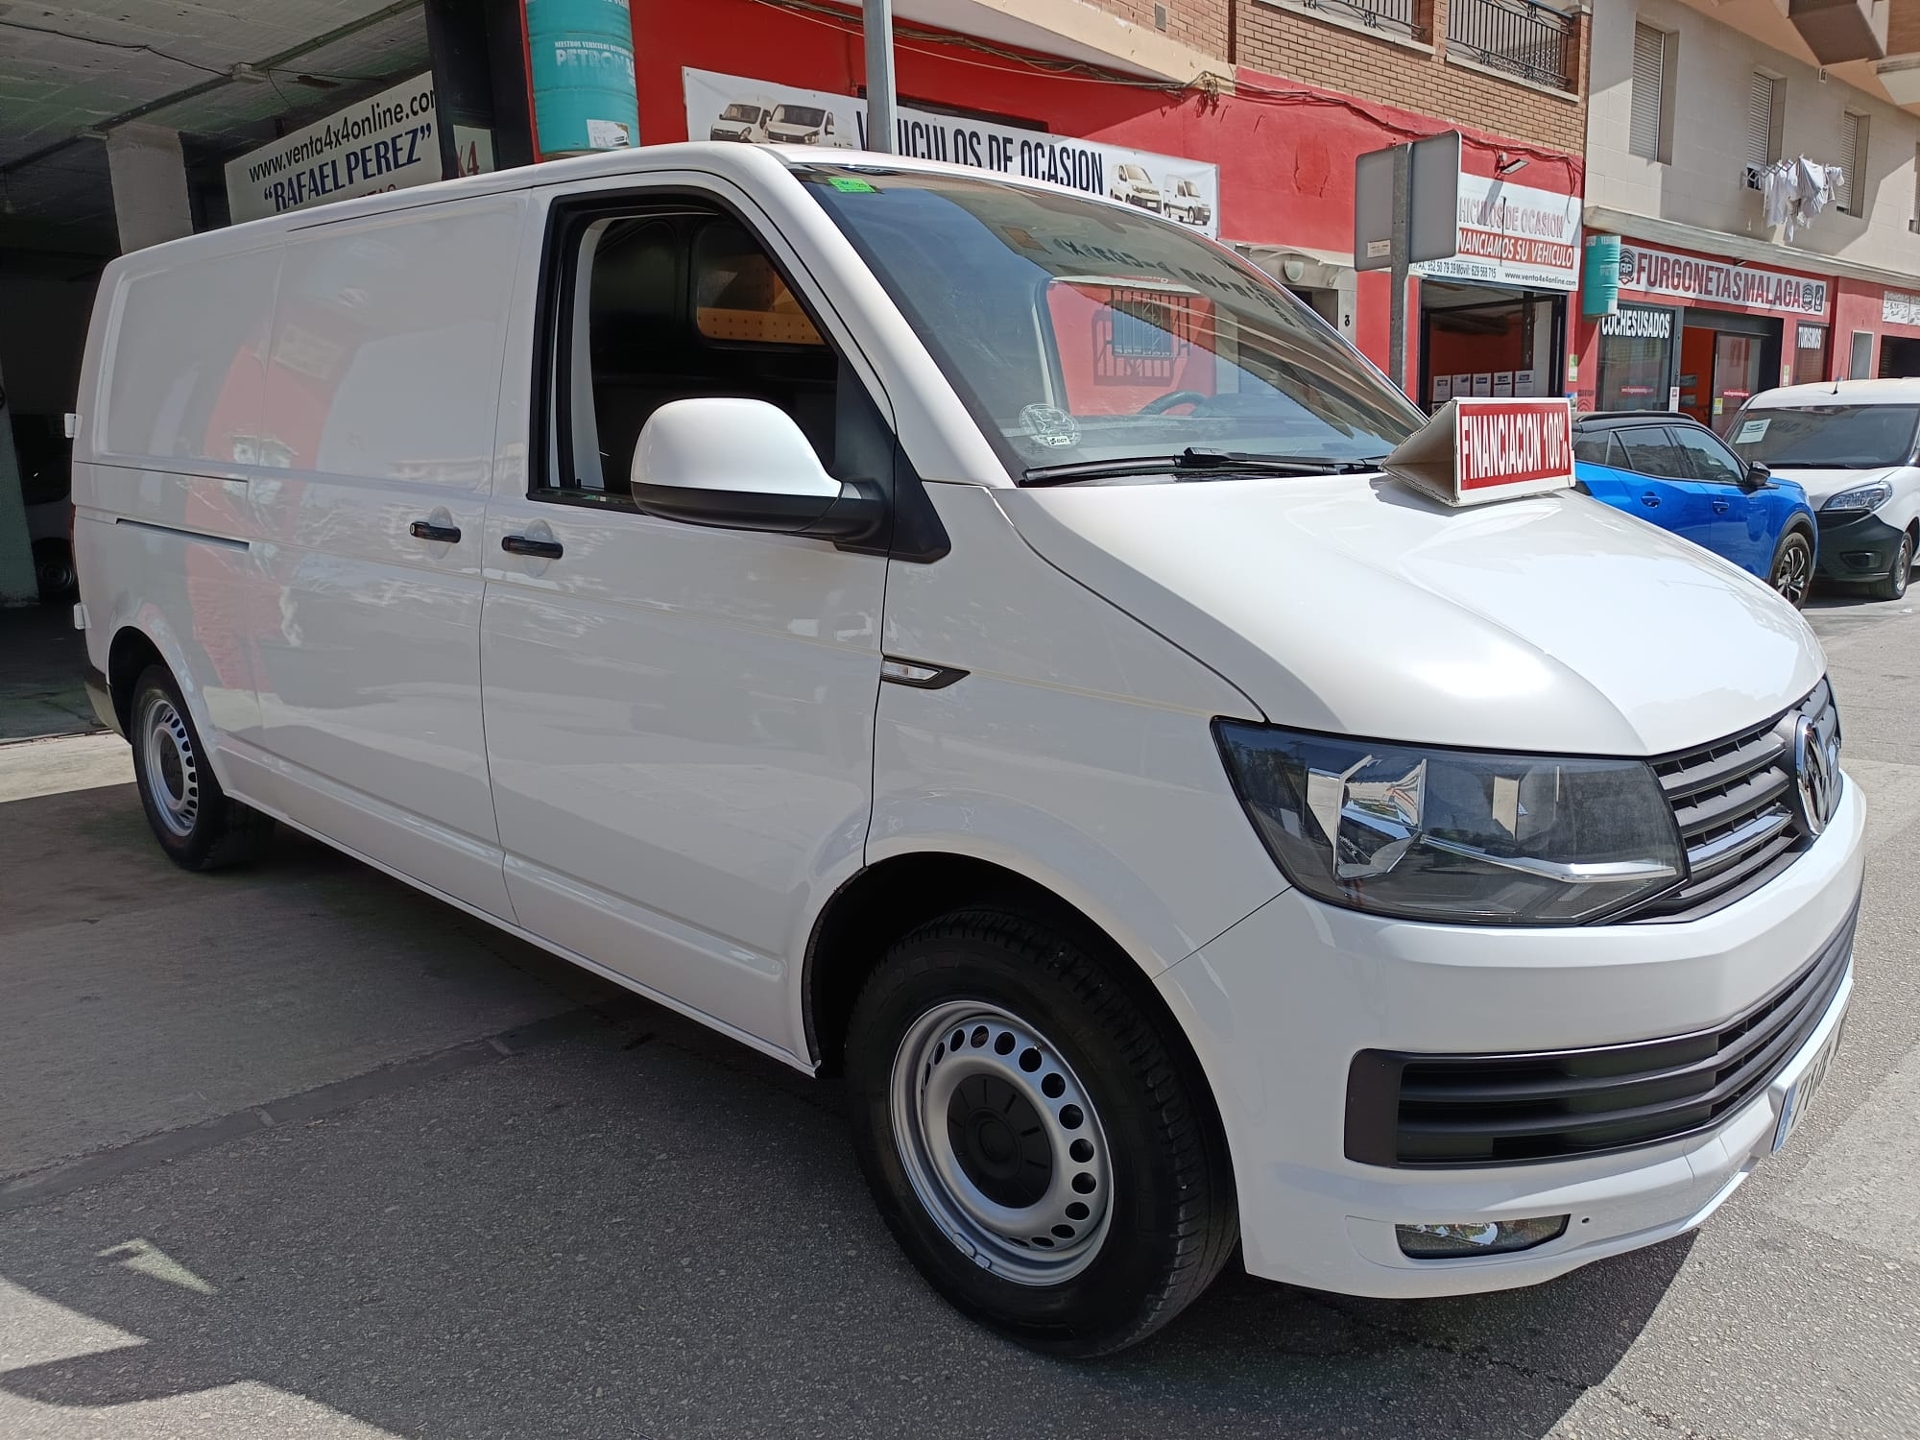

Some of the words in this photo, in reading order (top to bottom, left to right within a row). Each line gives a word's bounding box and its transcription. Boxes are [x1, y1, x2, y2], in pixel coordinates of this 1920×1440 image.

[988, 134, 1013, 173] DE
[1020, 140, 1103, 195] OCASION
[1505, 205, 1518, 231] DE
[1521, 207, 1564, 238] OCASION
[1515, 239, 1529, 261] SU
[1531, 241, 1573, 268] VEHICULO
[1461, 412, 1542, 481] FINANCIACION
[1542, 411, 1569, 471] 100%
